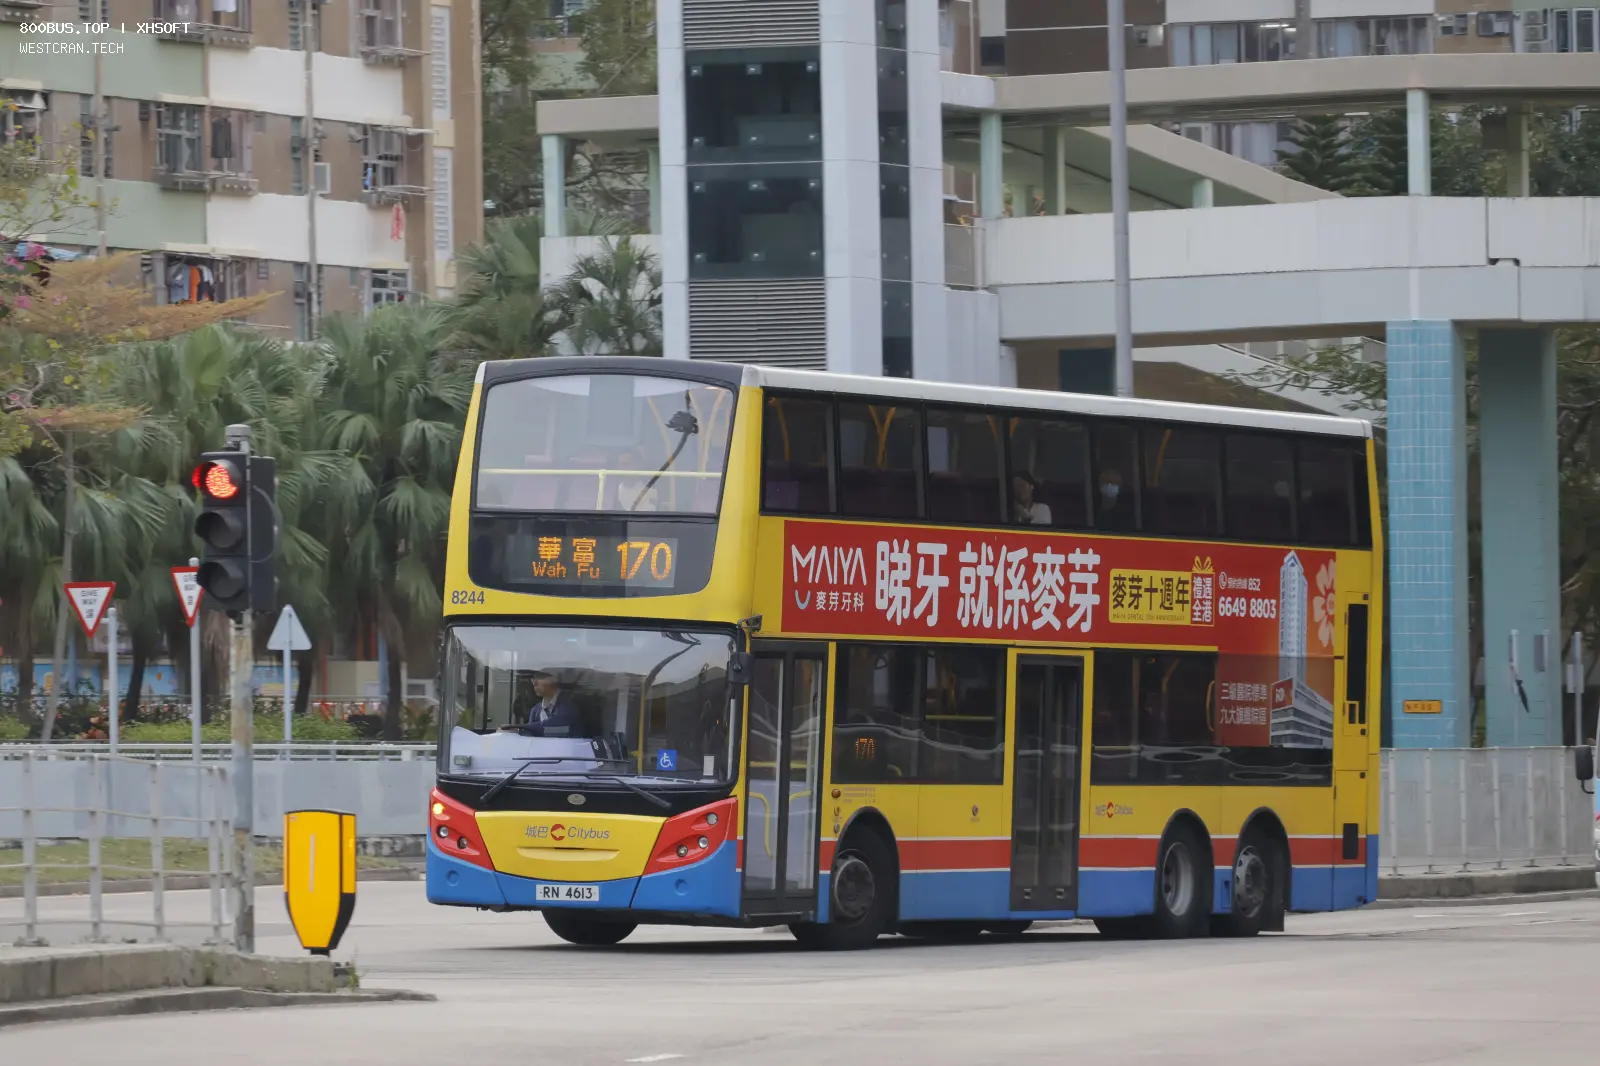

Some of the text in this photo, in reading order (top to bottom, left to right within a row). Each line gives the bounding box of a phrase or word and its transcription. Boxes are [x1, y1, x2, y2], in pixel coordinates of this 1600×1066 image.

[537, 536, 597, 563] 華富
[616, 541, 673, 580] 170
[531, 561, 600, 579] Wah Fu
[791, 544, 868, 586] MAIYA
[875, 538, 1101, 633] 睇牙 就係麥芽
[1112, 573, 1190, 612] 麥芽十週年
[1248, 578, 1261, 591] 852
[451, 590, 485, 605] 8244
[815, 590, 865, 613] 麥芽牙科
[1218, 596, 1277, 619] 6649 8803
[1192, 599, 1213, 622] 全港
[525, 825, 549, 839] 城巴
[567, 826, 610, 840] Citybus
[543, 886, 593, 899] RN 4613
